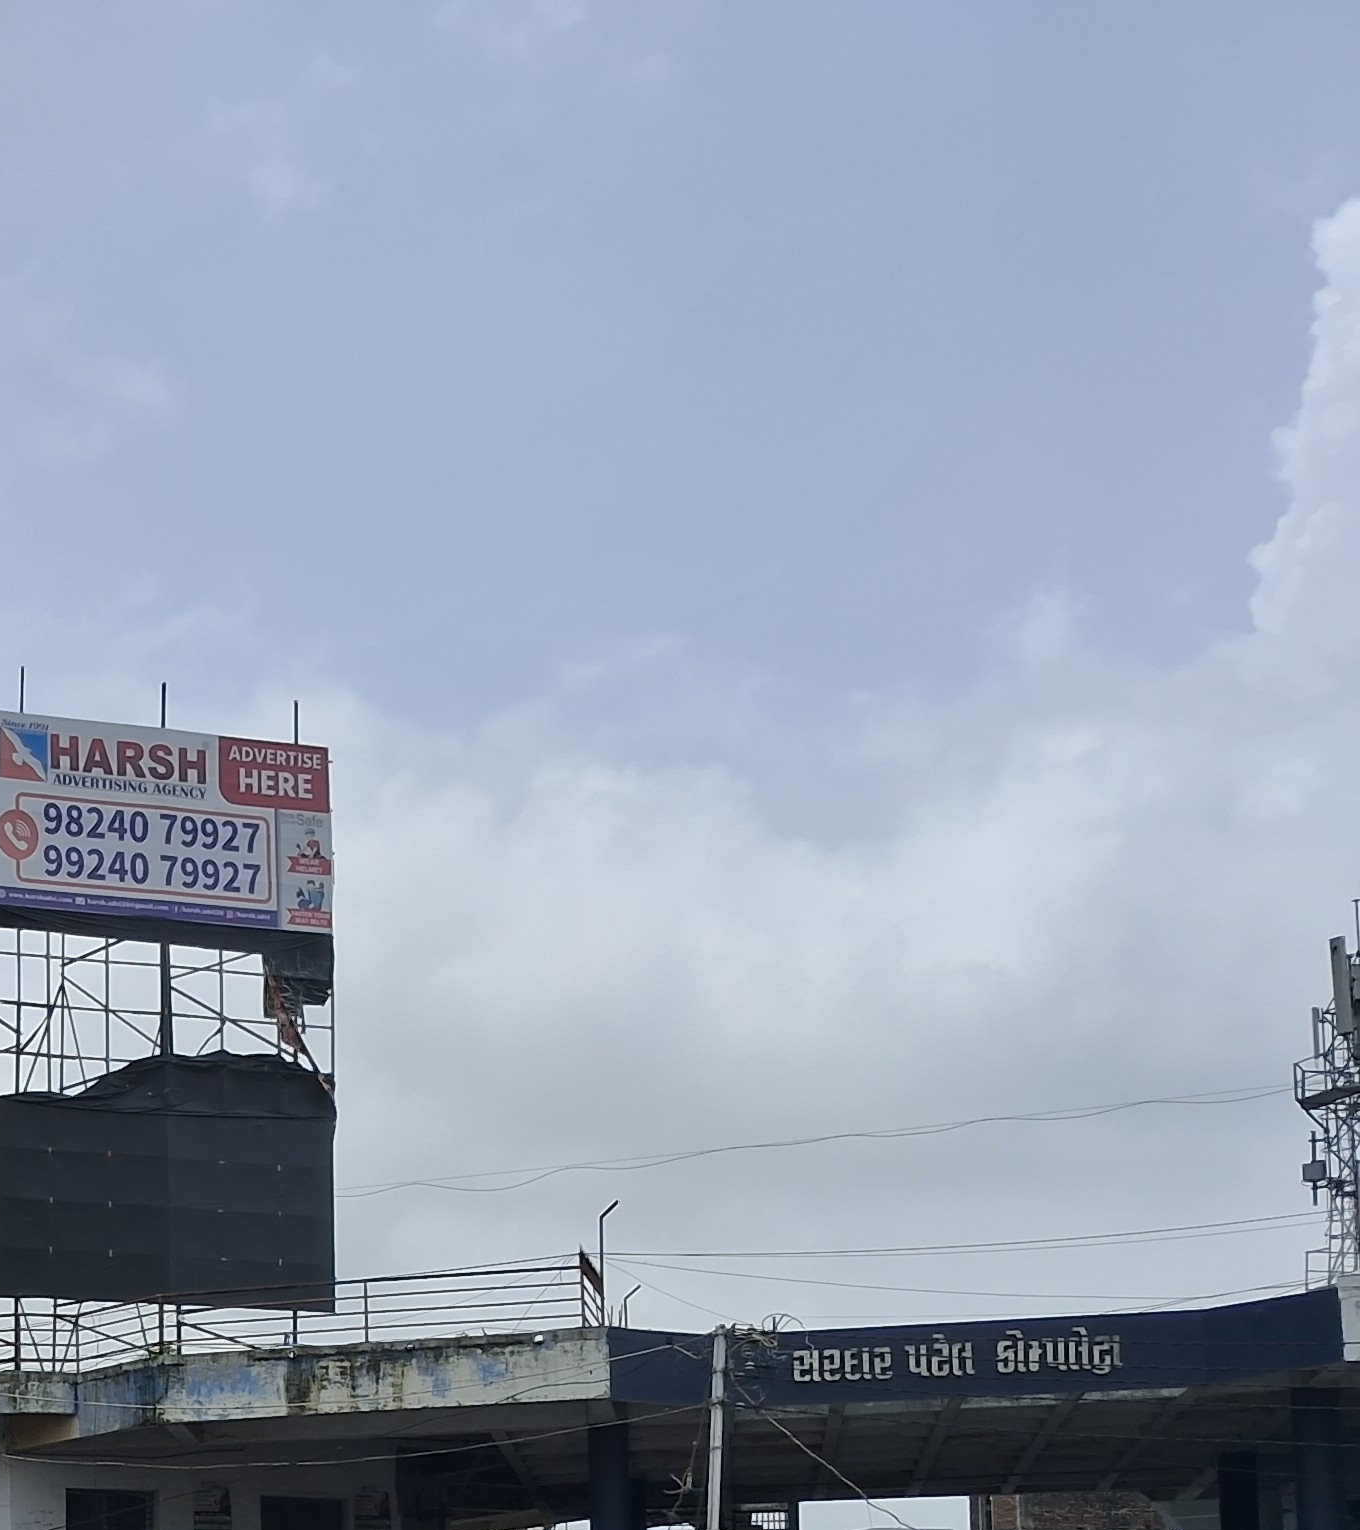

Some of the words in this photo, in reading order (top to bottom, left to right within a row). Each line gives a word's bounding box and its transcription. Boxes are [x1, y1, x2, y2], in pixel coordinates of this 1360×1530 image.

[50, 733, 208, 785] HARSH
[228, 744, 322, 770] ADVERTISE
[53, 773, 148, 795] ADVERTISING
[152, 782, 208, 800] AGENCY
[238, 767, 314, 800] HERE
[43, 801, 149, 844] 98240
[159, 813, 260, 854] 79927
[296, 812, 324, 828] Safe
[43, 844, 149, 885] 99240
[159, 854, 261, 895] 79927
[793, 1346, 893, 1382] સરદાર
[905, 1333, 976, 1377] પટેલ
